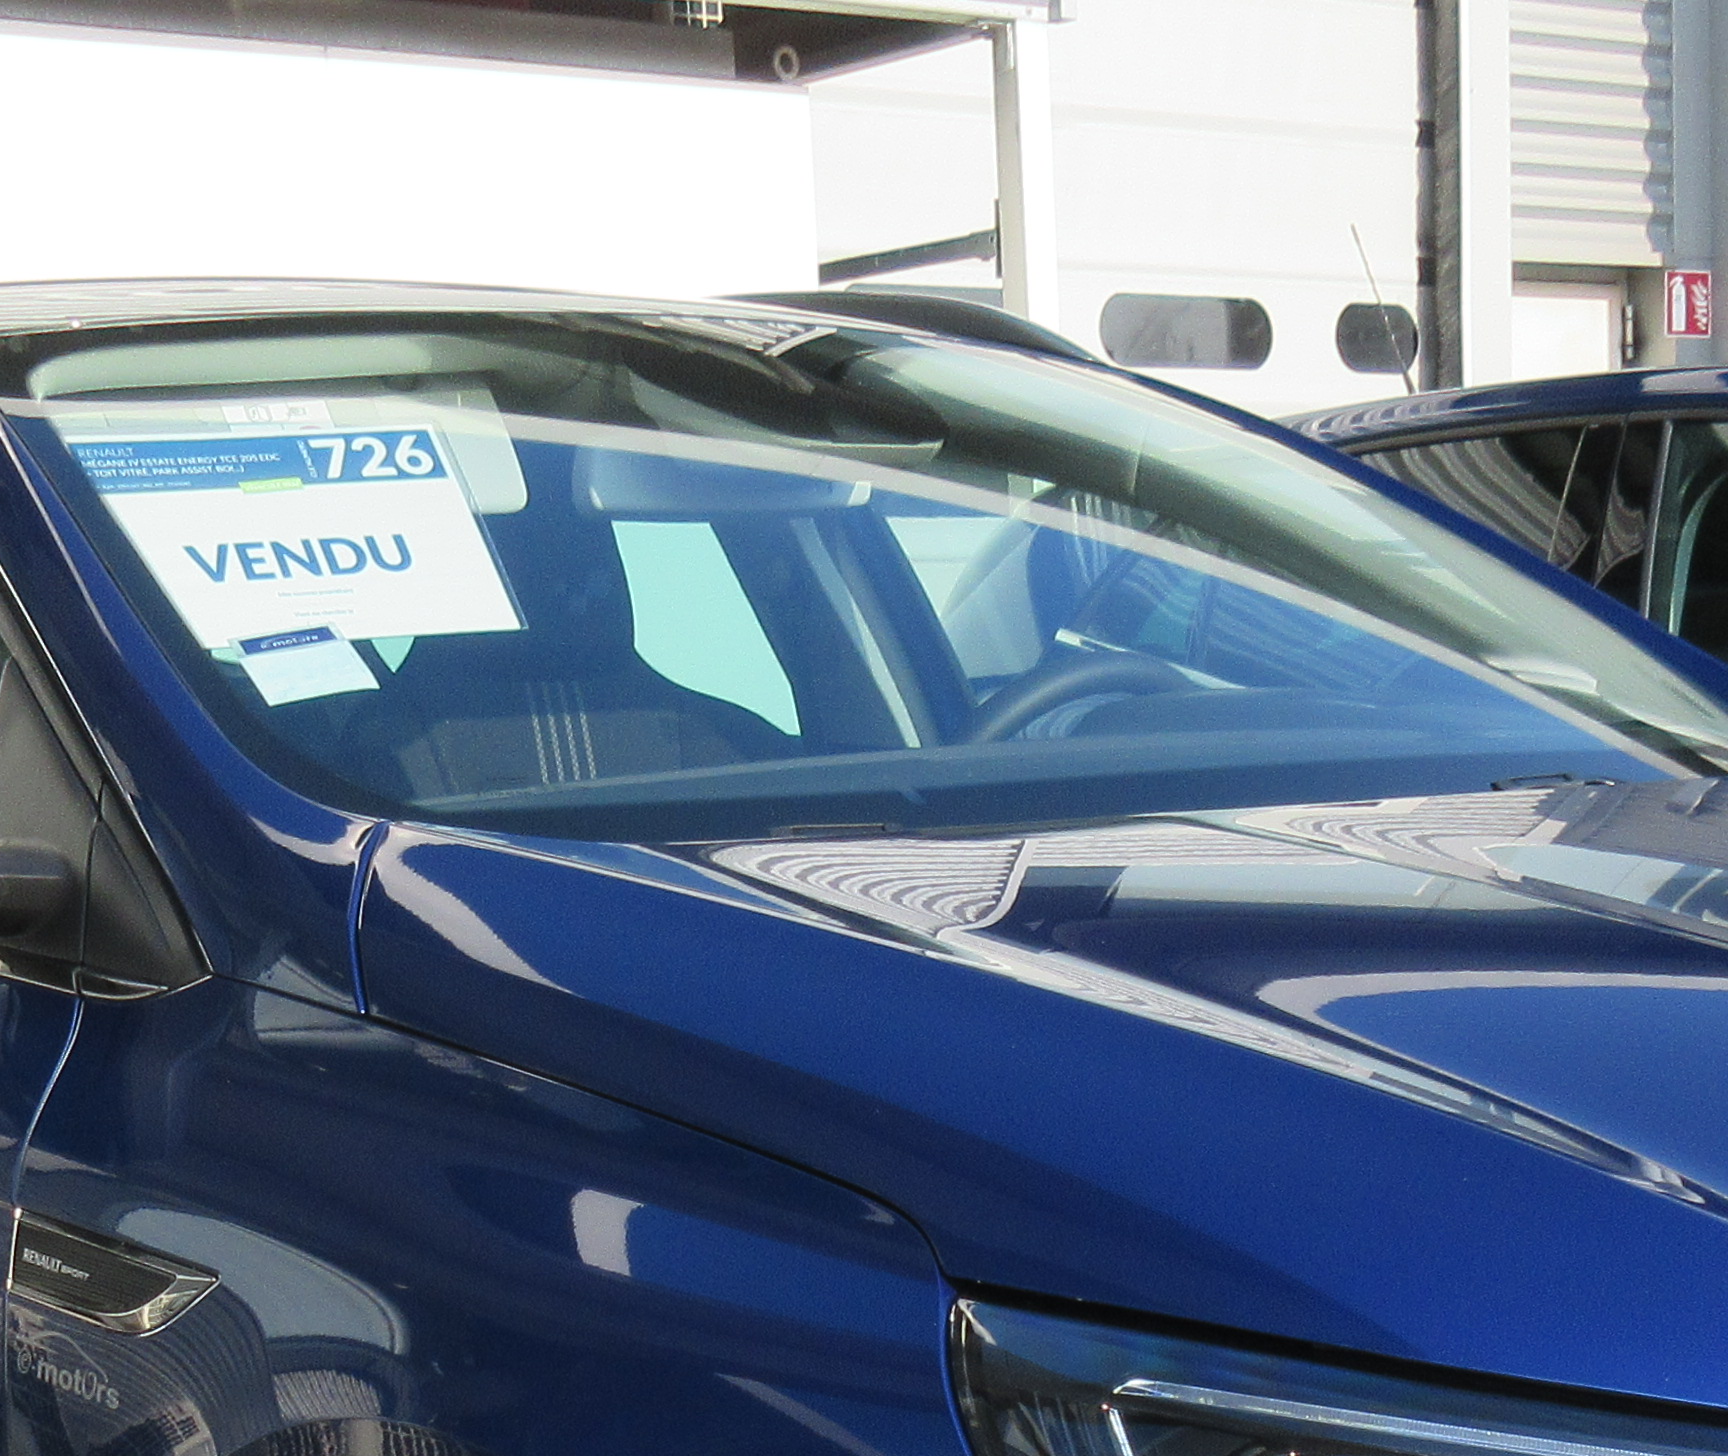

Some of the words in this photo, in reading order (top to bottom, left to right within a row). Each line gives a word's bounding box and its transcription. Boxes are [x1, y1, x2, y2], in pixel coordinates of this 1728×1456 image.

[77, 448, 134, 458] RENAULT
[141, 457, 176, 467] ESTATE
[177, 456, 217, 465] ENERGY
[307, 435, 434, 479] 726
[184, 534, 412, 583] VENDU
[22, 1247, 63, 1274] RENAULT
